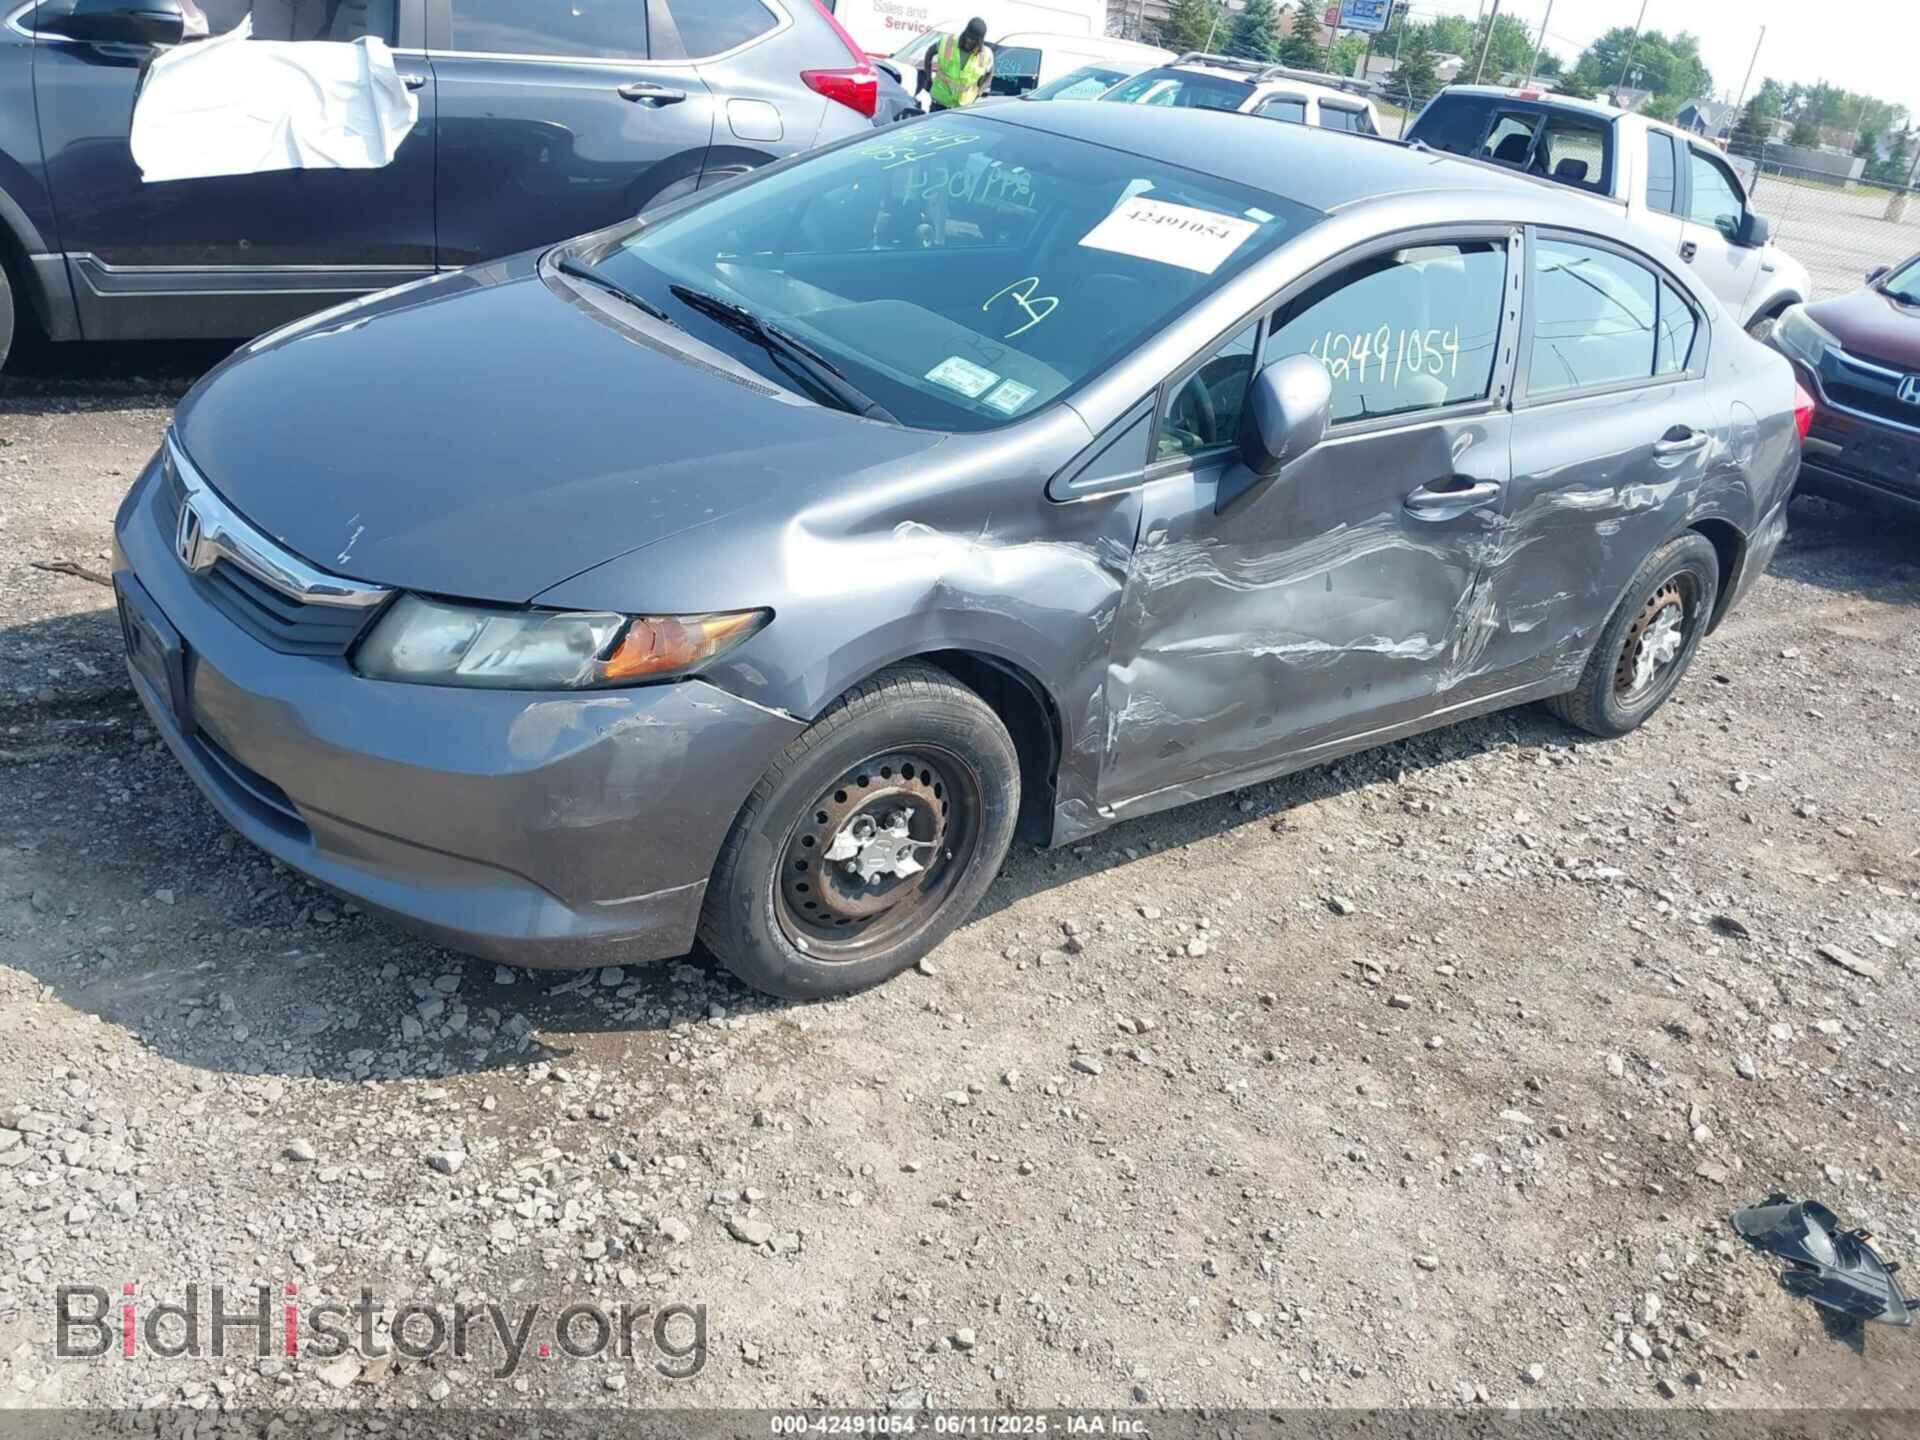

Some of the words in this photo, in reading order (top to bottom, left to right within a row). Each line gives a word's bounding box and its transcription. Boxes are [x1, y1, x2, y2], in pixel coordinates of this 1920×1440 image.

[873, 0, 904, 16] Sales
[885, 16, 933, 33] Service
[1127, 210, 1231, 239] 42491054
[982, 276, 1059, 339] B
